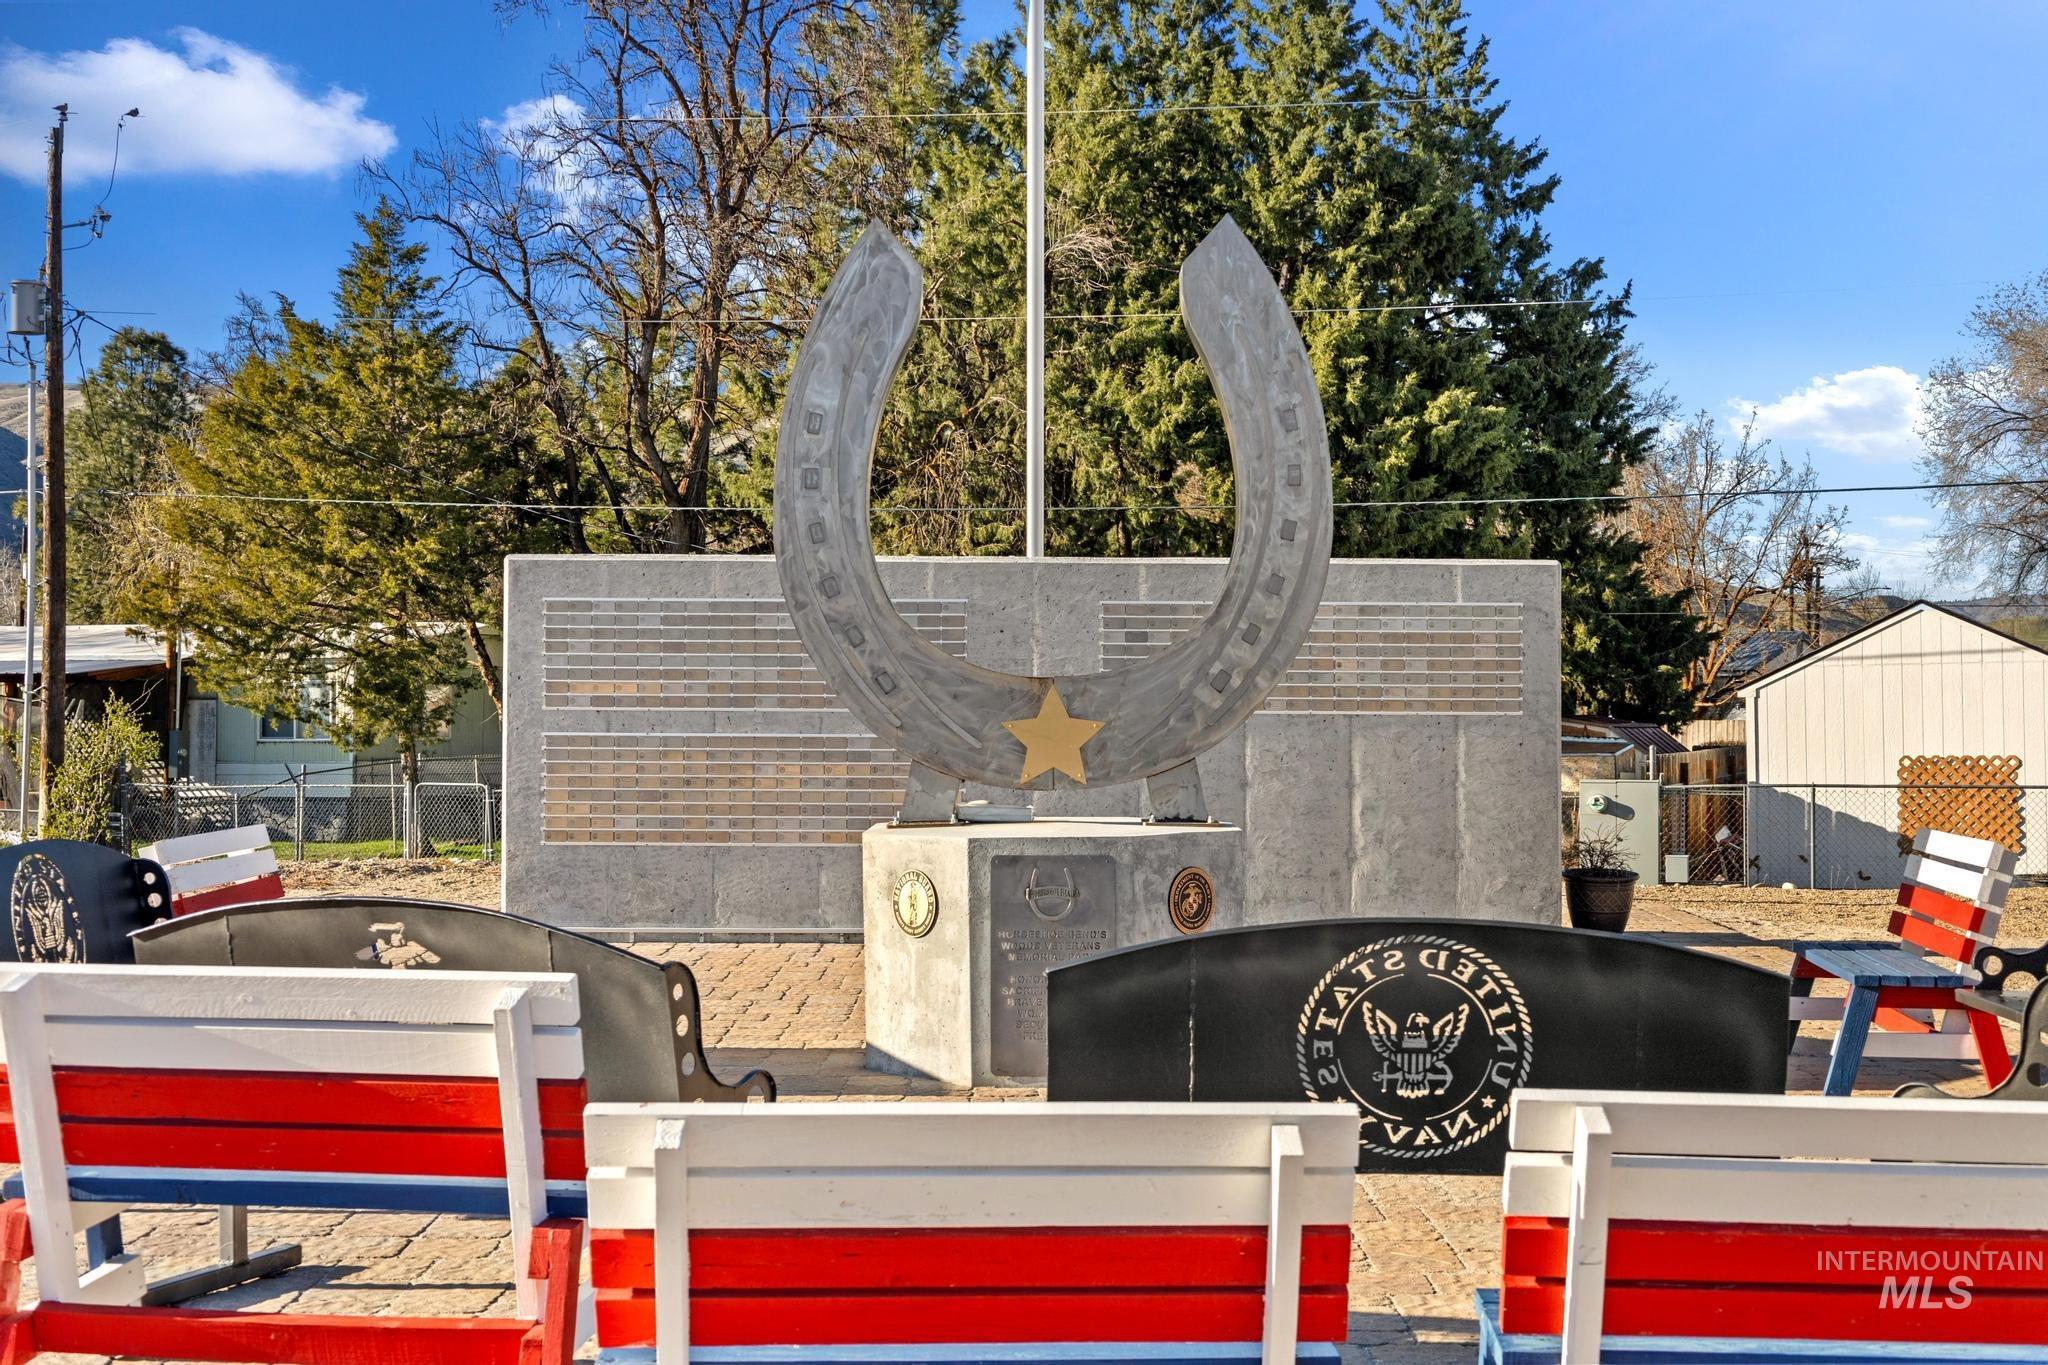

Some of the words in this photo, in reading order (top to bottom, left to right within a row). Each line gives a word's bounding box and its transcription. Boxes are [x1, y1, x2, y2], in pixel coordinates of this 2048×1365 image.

[893, 871, 918, 901] NATIONAL
[918, 874, 934, 903] GUARD
[1045, 941, 1101, 950] VETERANS
[1008, 952, 1064, 961] MEMORIAL
